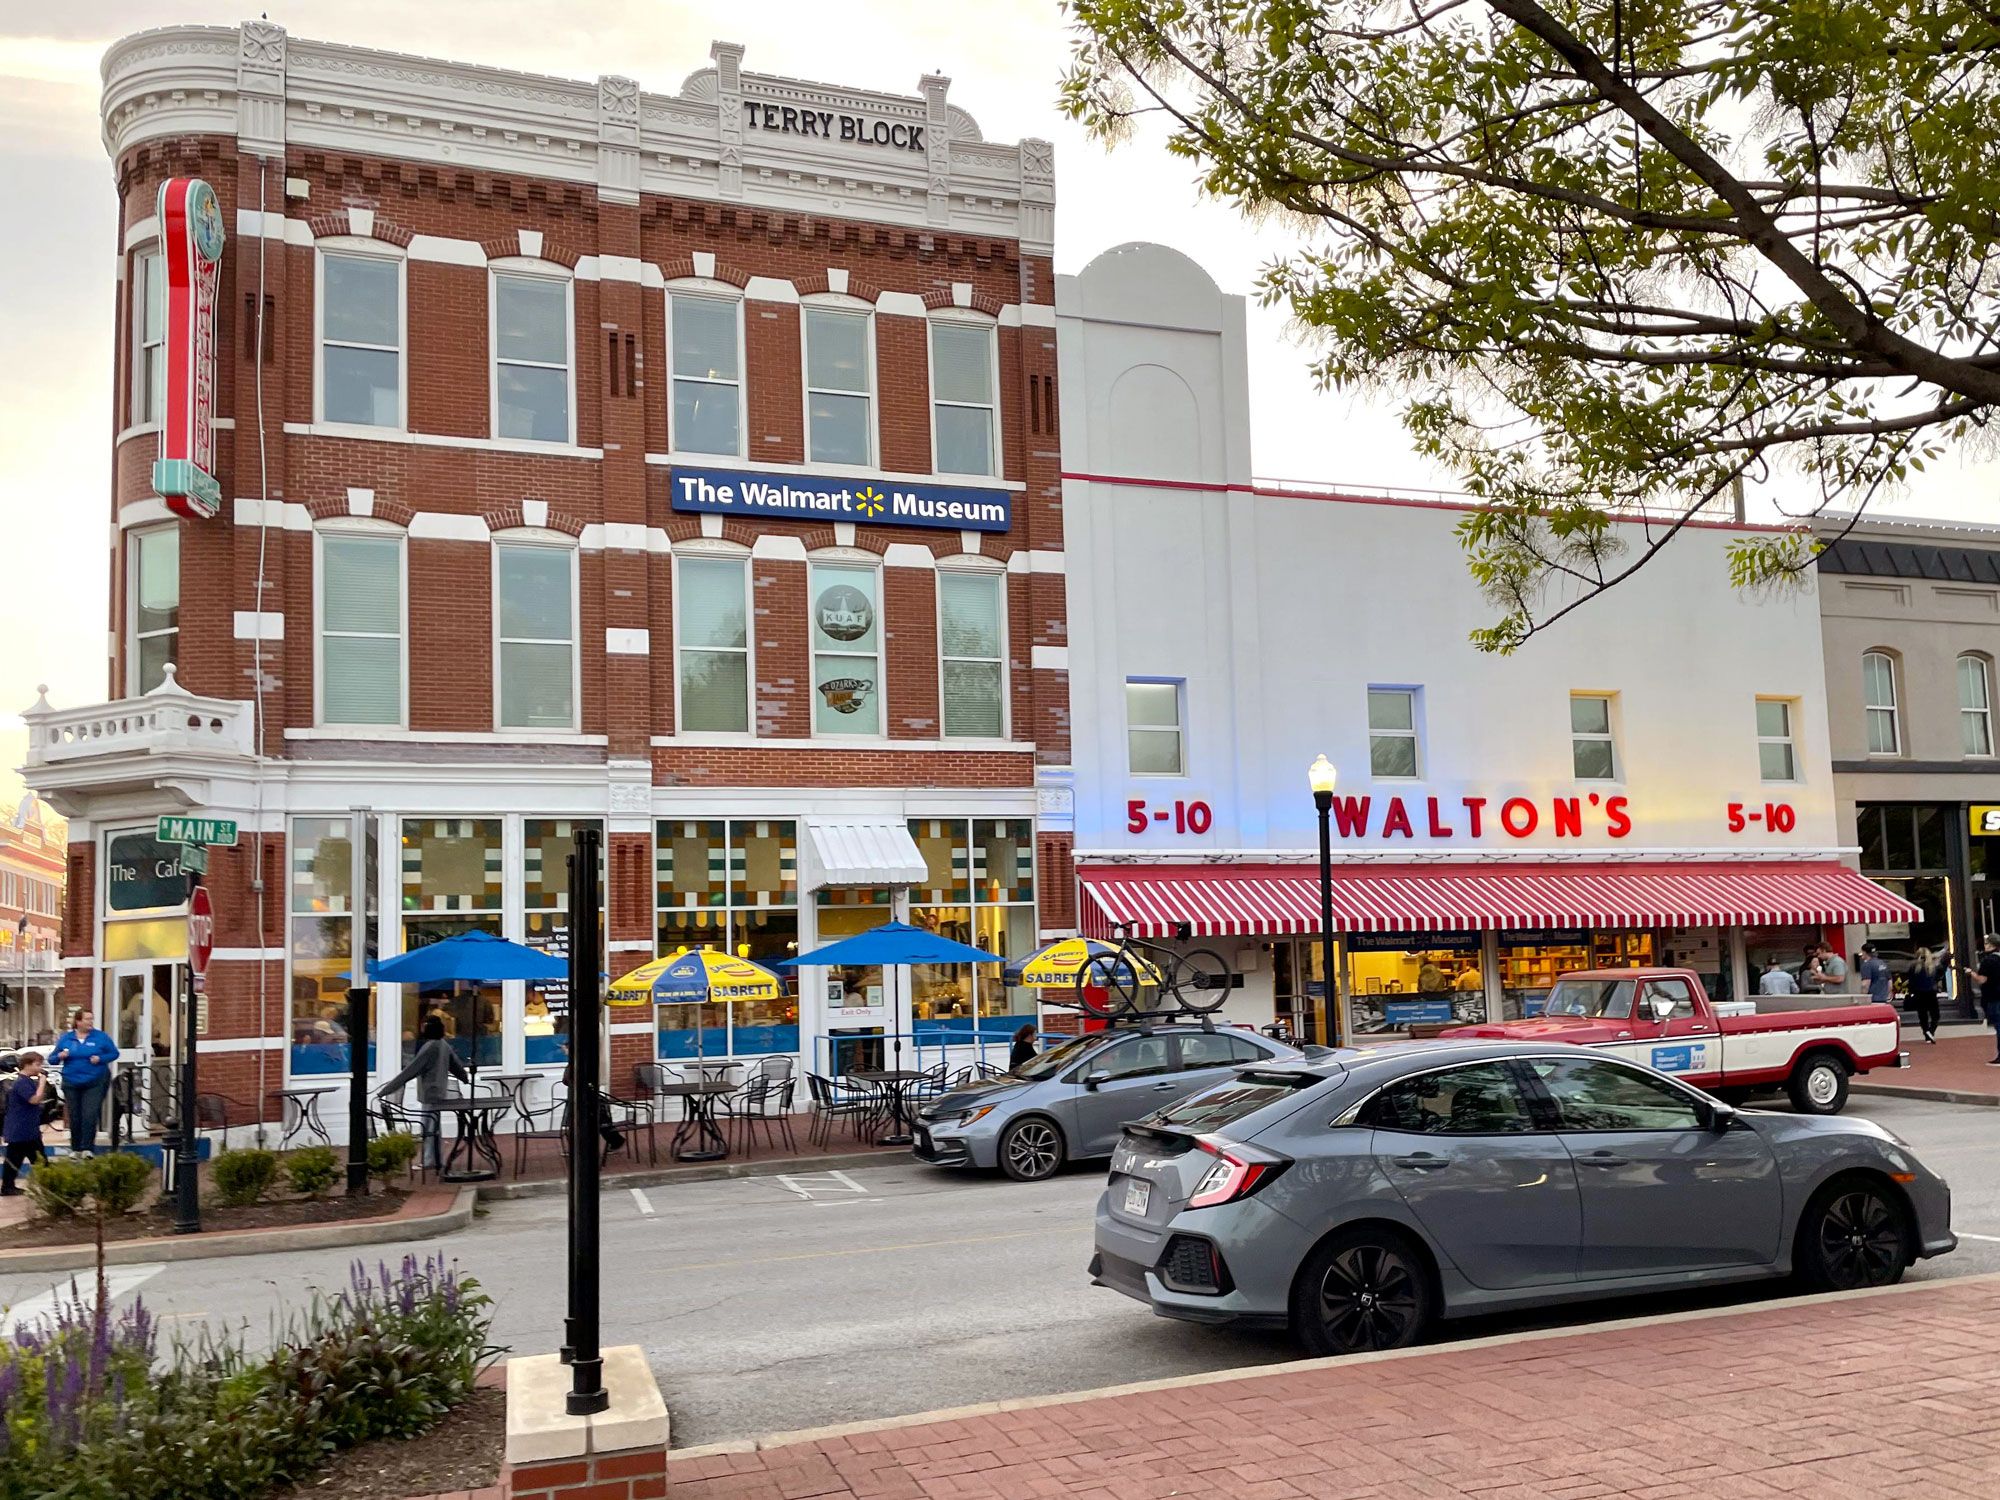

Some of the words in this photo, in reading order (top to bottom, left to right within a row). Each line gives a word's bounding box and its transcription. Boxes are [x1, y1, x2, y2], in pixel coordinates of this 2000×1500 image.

[744, 101, 834, 140] TERRY
[839, 115, 925, 152] BLOCK
[678, 477, 733, 504] The
[740, 482, 852, 512] Walmart
[893, 492, 1005, 522] Museum
[170, 820, 214, 841] MAIN
[220, 822, 231, 833] ST
[1127, 800, 1212, 834] 5-10
[1332, 792, 1632, 839] WALTON'S
[1727, 803, 1795, 833] 5-10
[110, 864, 137, 882] The
[190, 914, 212, 947] STOP
[1357, 937, 1374, 946] The
[1376, 936, 1415, 946] Walmart
[1432, 935, 1473, 944] Museum
[607, 989, 648, 1001] SABRET
[714, 984, 773, 997] SABRETT
